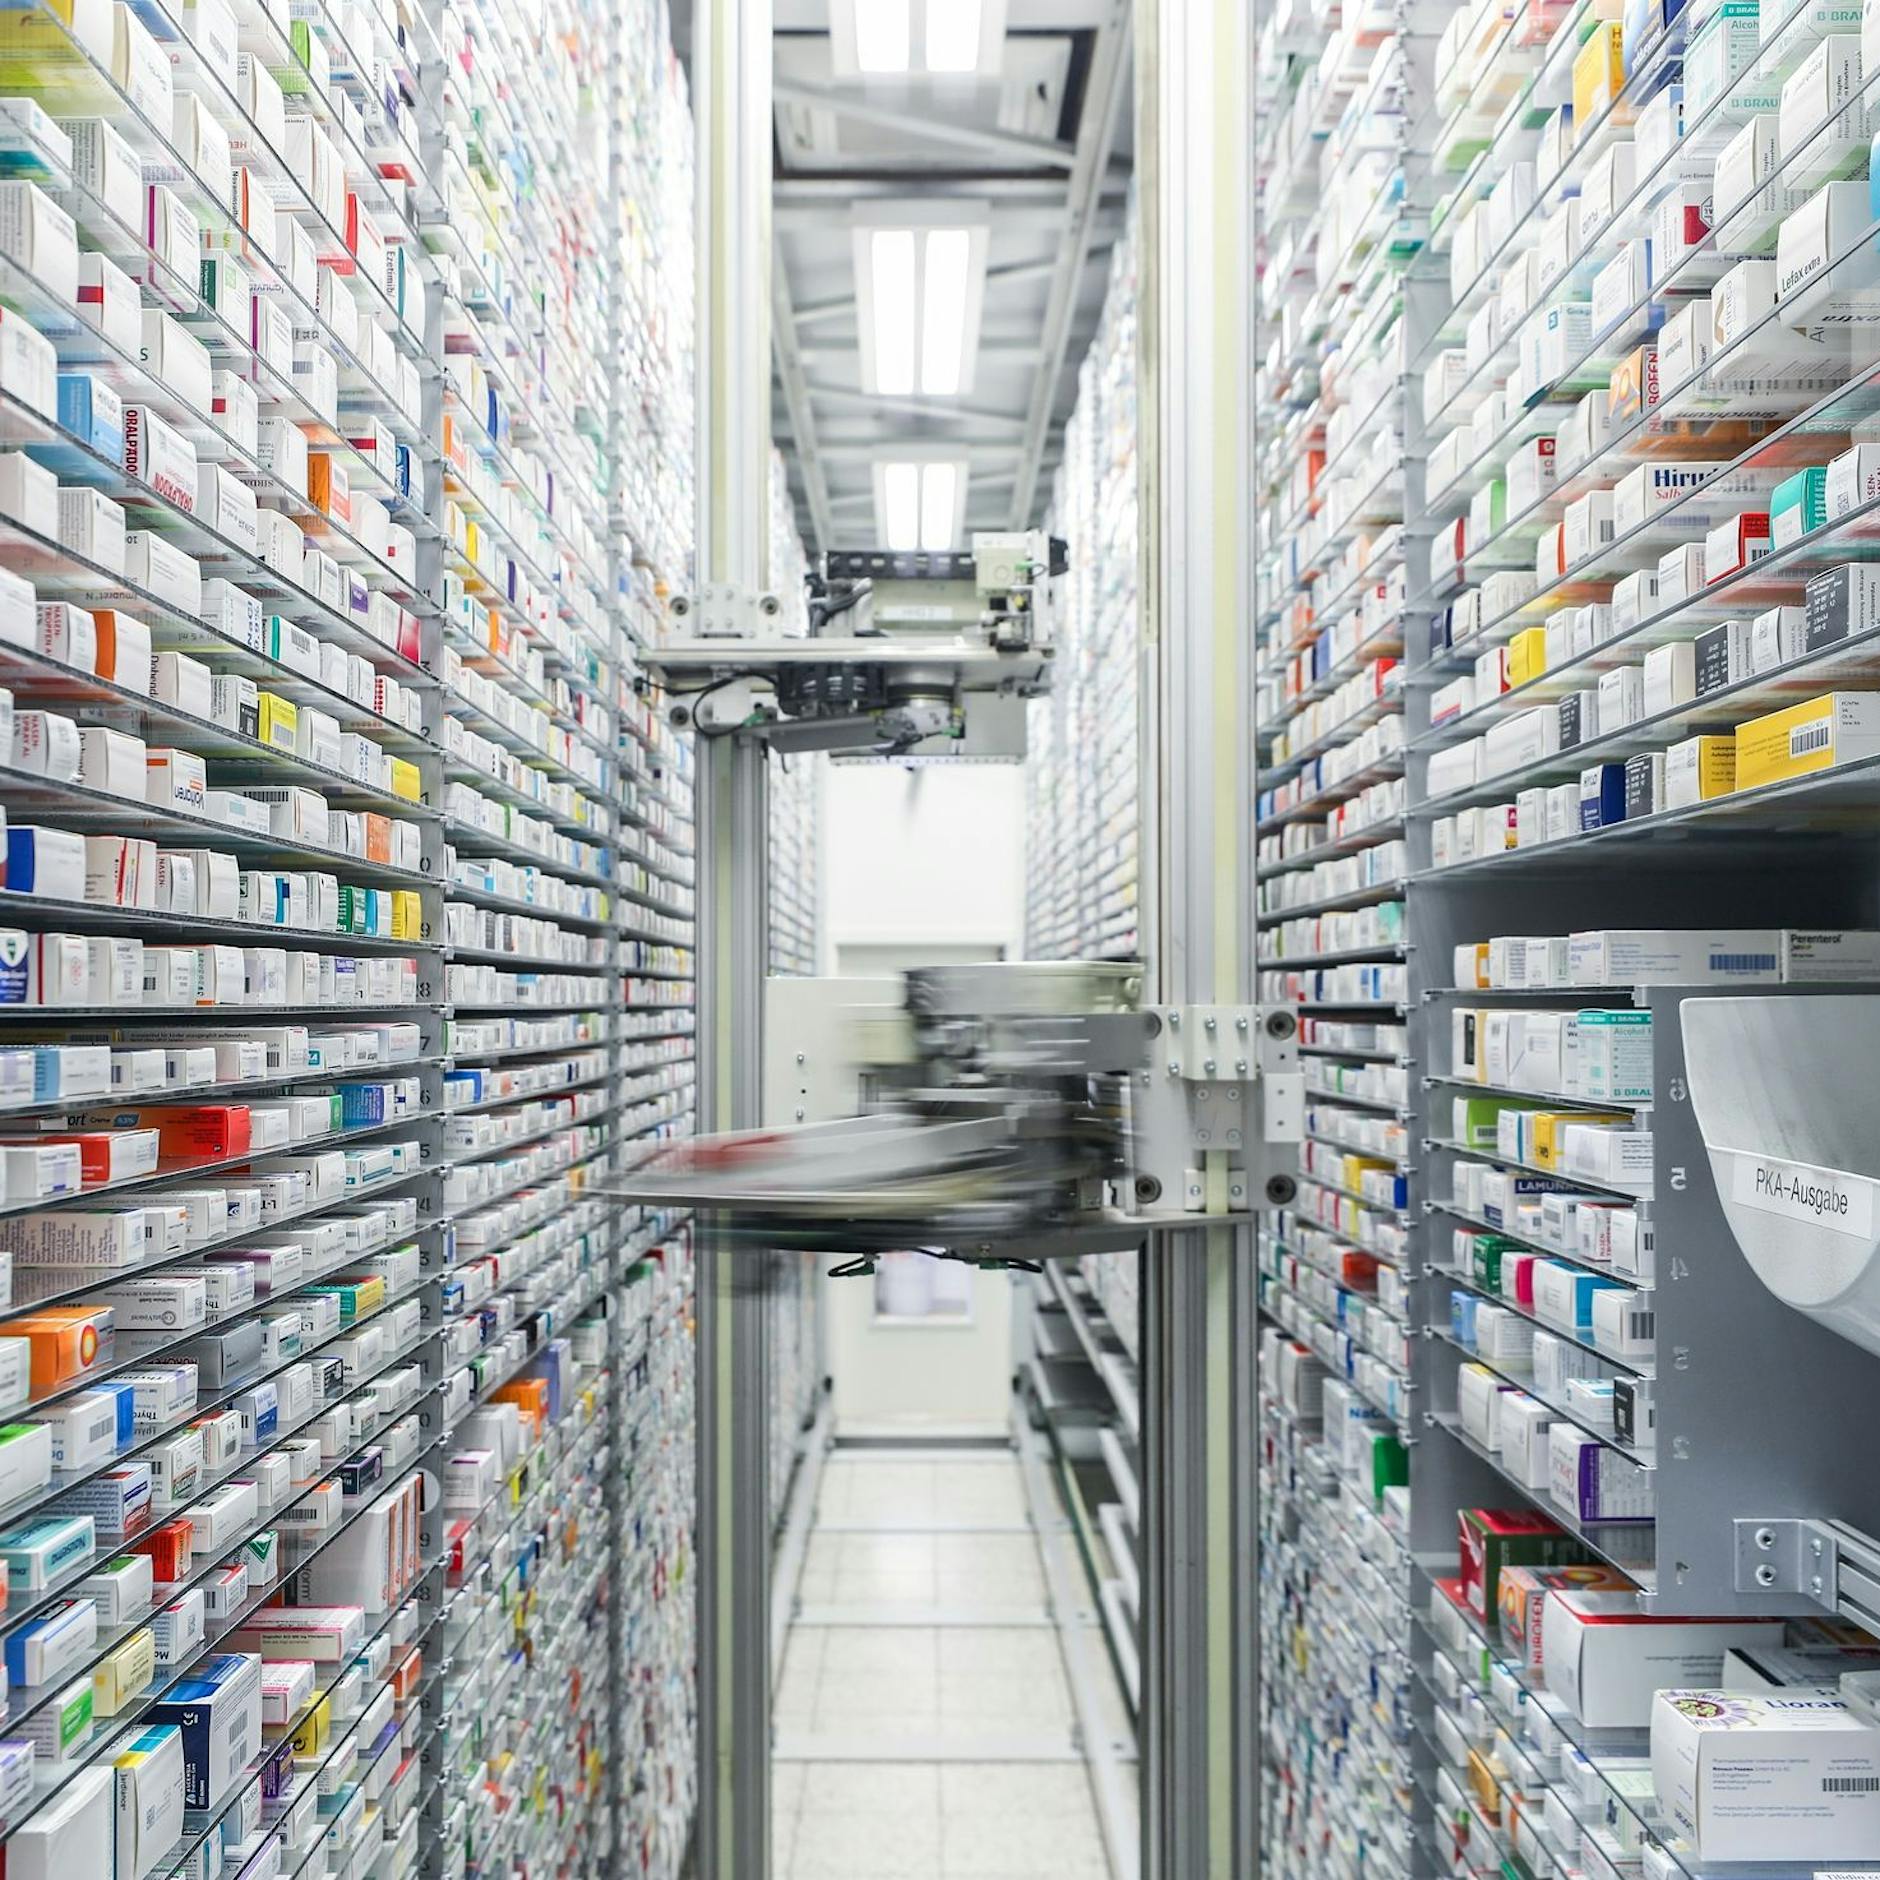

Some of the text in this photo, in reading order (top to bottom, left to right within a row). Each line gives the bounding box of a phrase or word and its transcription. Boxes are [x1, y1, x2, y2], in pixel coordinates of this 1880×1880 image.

[174, 785, 205, 810] Voltaren
[420, 1036, 431, 1051] 7
[1755, 1167, 1849, 1216] PKA-Ausgabe
[1532, 1596, 1543, 1664] NUROFEN
[1766, 1699, 1849, 1709] Lioran
